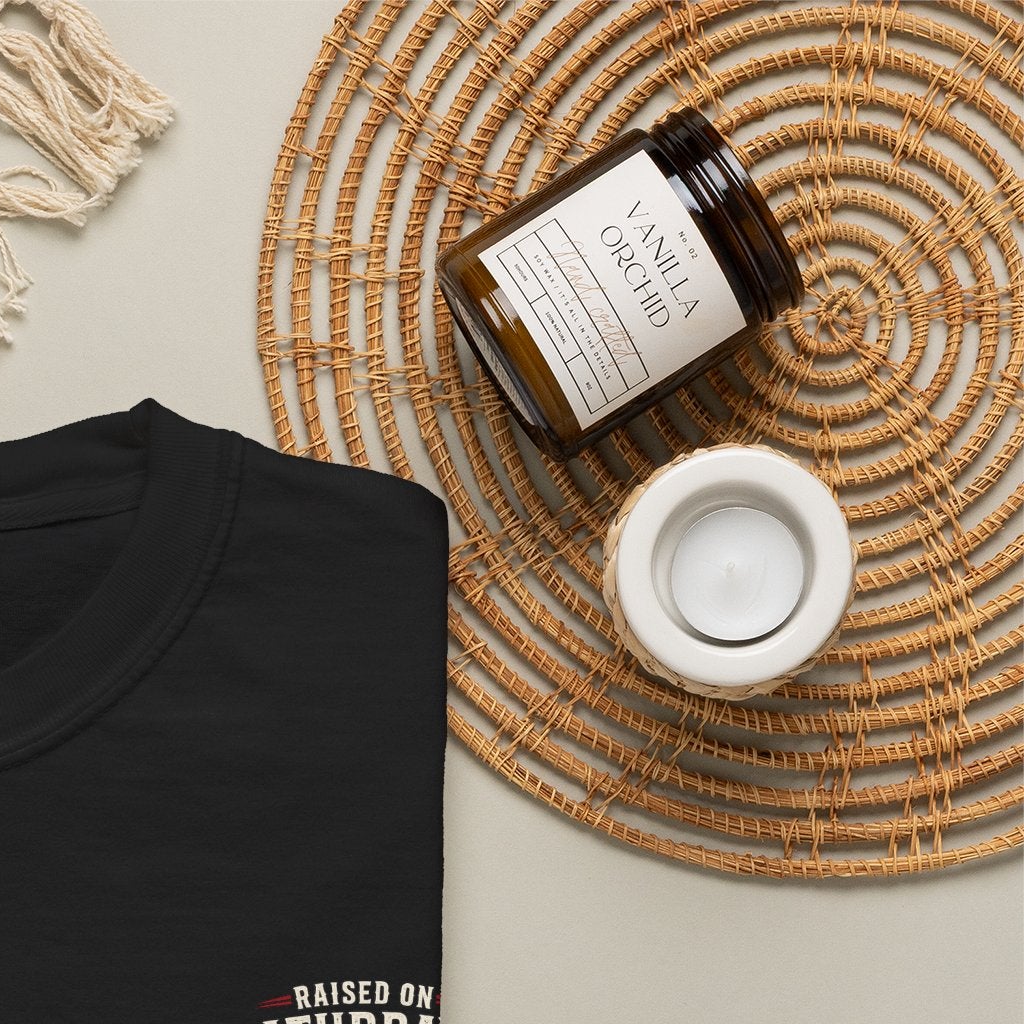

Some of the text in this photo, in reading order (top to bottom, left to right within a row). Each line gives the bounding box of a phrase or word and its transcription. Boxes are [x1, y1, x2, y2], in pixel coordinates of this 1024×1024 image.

[601, 225, 671, 328] ORCHID
[627, 200, 701, 319] VANILLA
[678, 230, 698, 259] No. 02
[534, 255, 544, 266] SOY
[544, 269, 555, 283] WAX
[558, 291, 569, 306] IT'S
[569, 309, 578, 322] ALL
[578, 325, 585, 333] IN
[585, 336, 595, 349] THE
[594, 352, 611, 380] DETAILS
[553, 324, 566, 344] NATURAL
[293, 981, 434, 1009] RAISED ON
